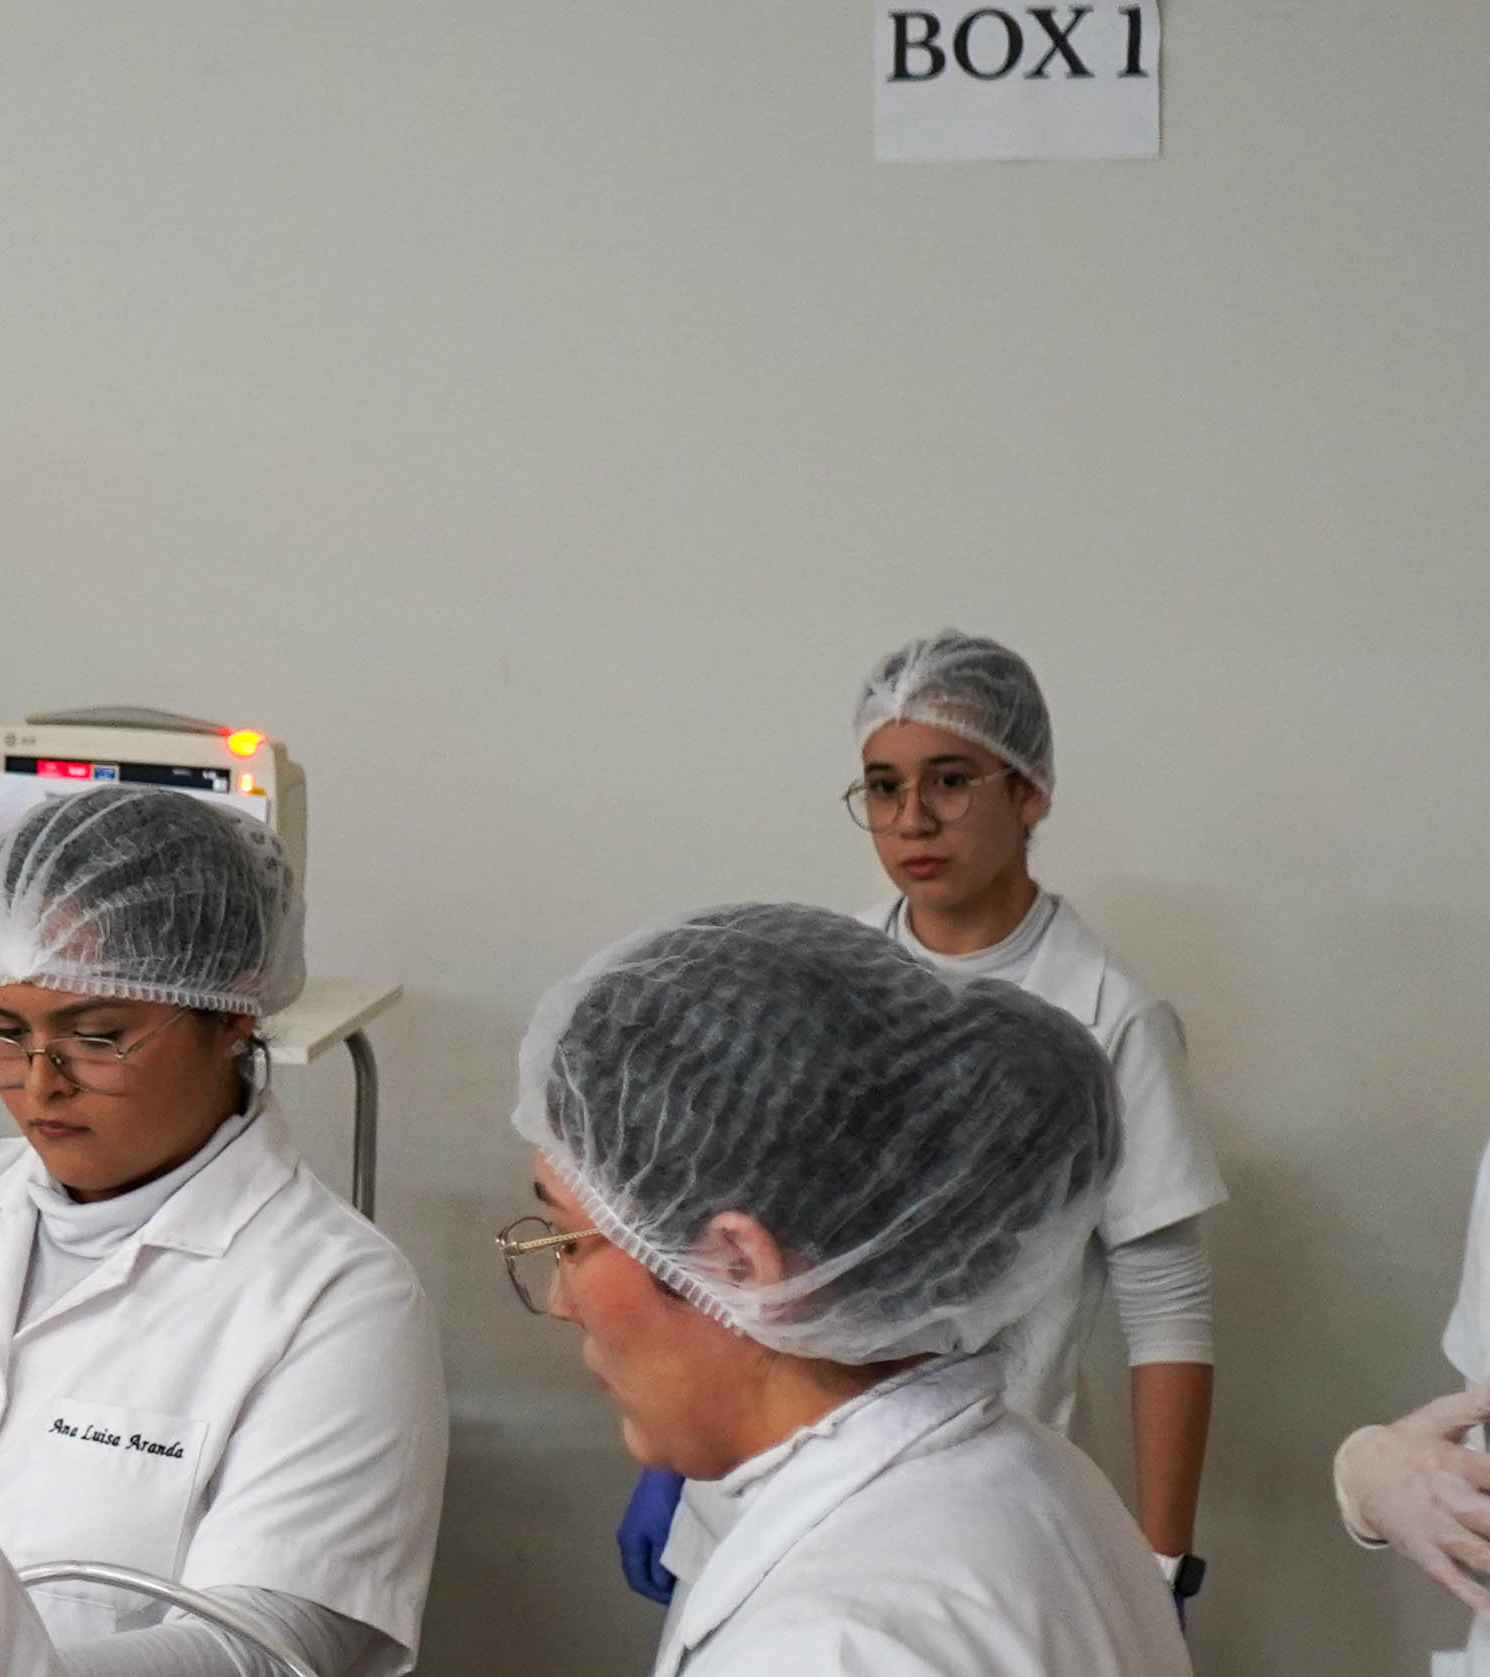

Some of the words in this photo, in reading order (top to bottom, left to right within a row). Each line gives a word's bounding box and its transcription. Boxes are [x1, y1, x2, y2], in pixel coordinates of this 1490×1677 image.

[886, 6, 1095, 83] BOX
[1117, 6, 1149, 79] 1
[48, 1418, 78, 1438] Ana
[80, 1424, 121, 1447] Luisa
[124, 1433, 185, 1459] Aranda
